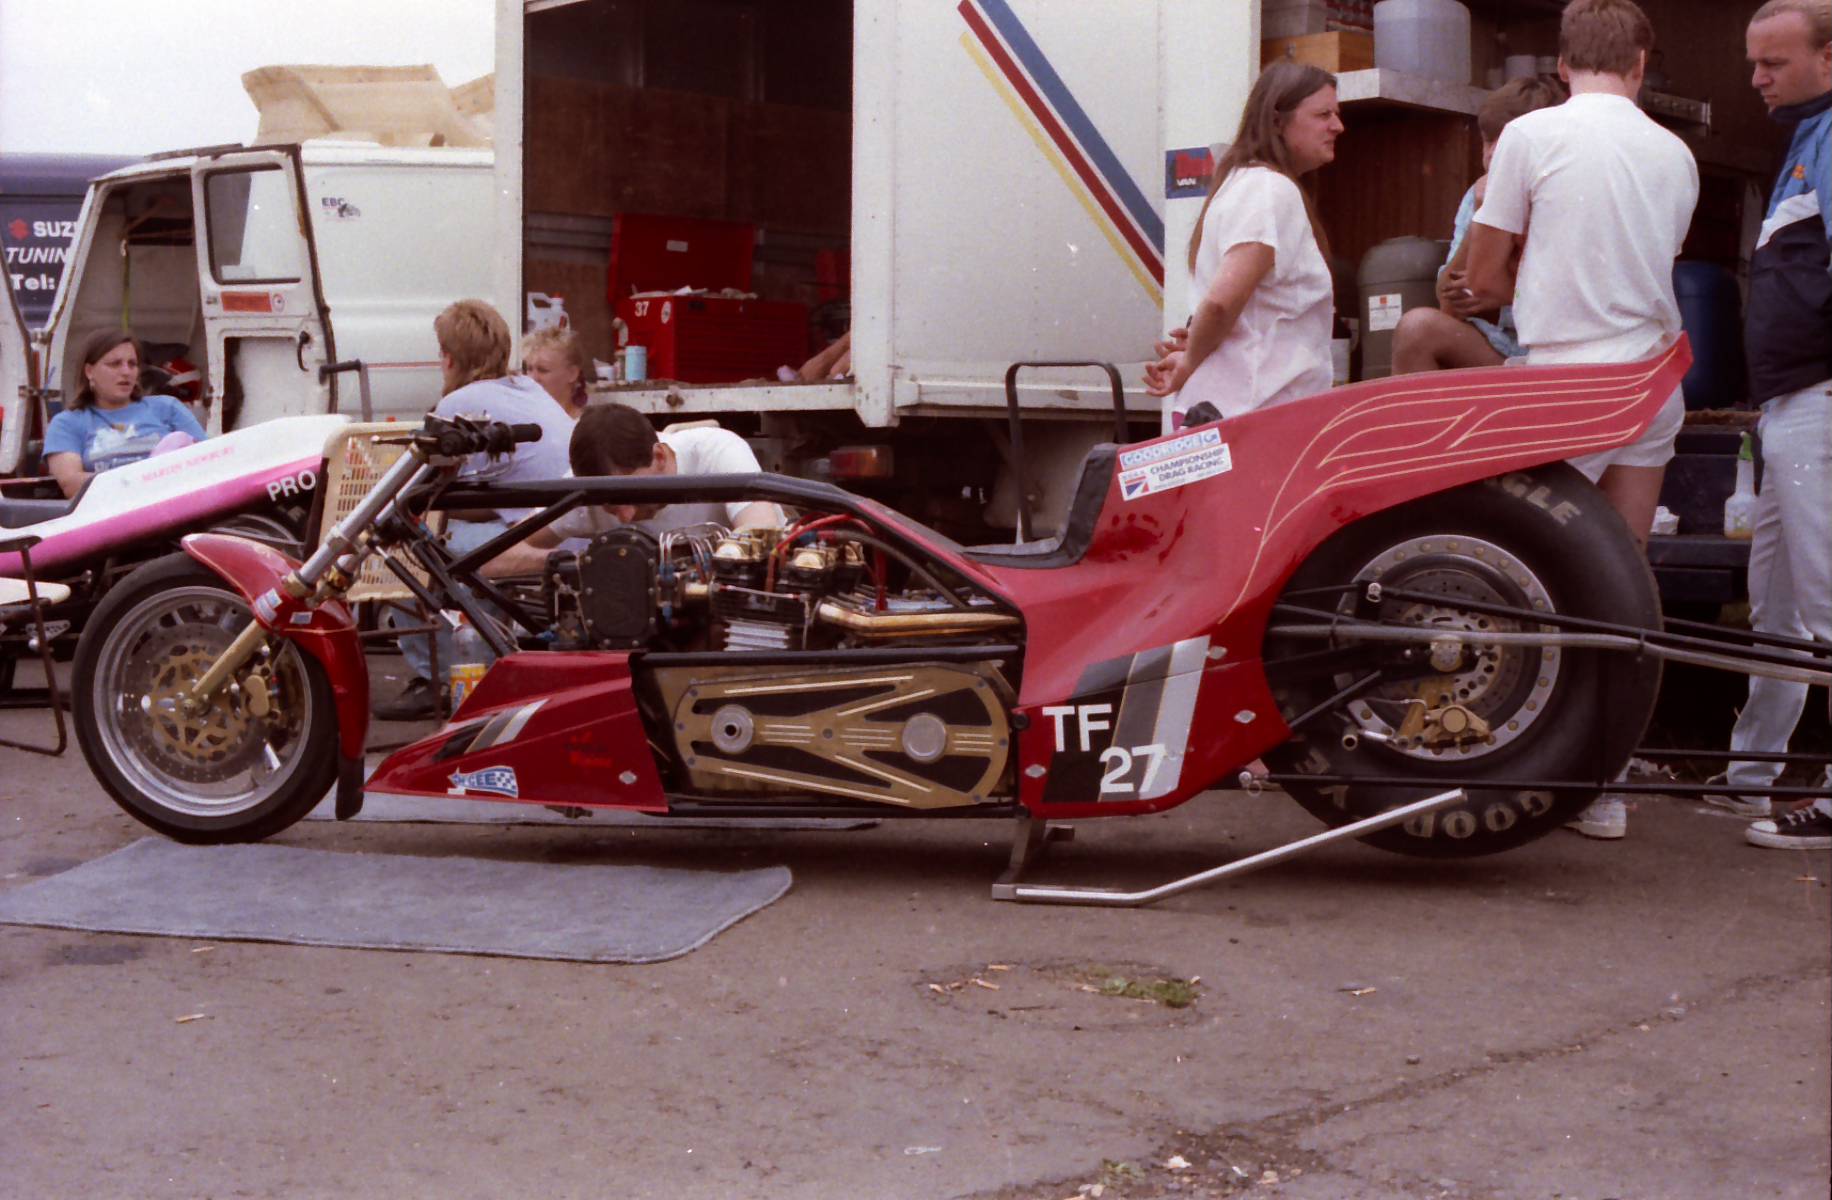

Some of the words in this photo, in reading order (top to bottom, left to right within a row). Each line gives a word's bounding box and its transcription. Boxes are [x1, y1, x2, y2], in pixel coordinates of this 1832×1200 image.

[32, 221, 78, 238] SUZ
[6, 247, 71, 264] TUNIN
[10, 273, 55, 291] Tel:
[634, 300, 649, 317] 37
[1150, 447, 1225, 475] CHAMPIONSHIP
[1159, 466, 1187, 481] DRAG
[1187, 457, 1225, 474] RACING
[266, 469, 317, 502] PRO
[1042, 703, 1112, 752] TF
[1099, 743, 1166, 793] 27
